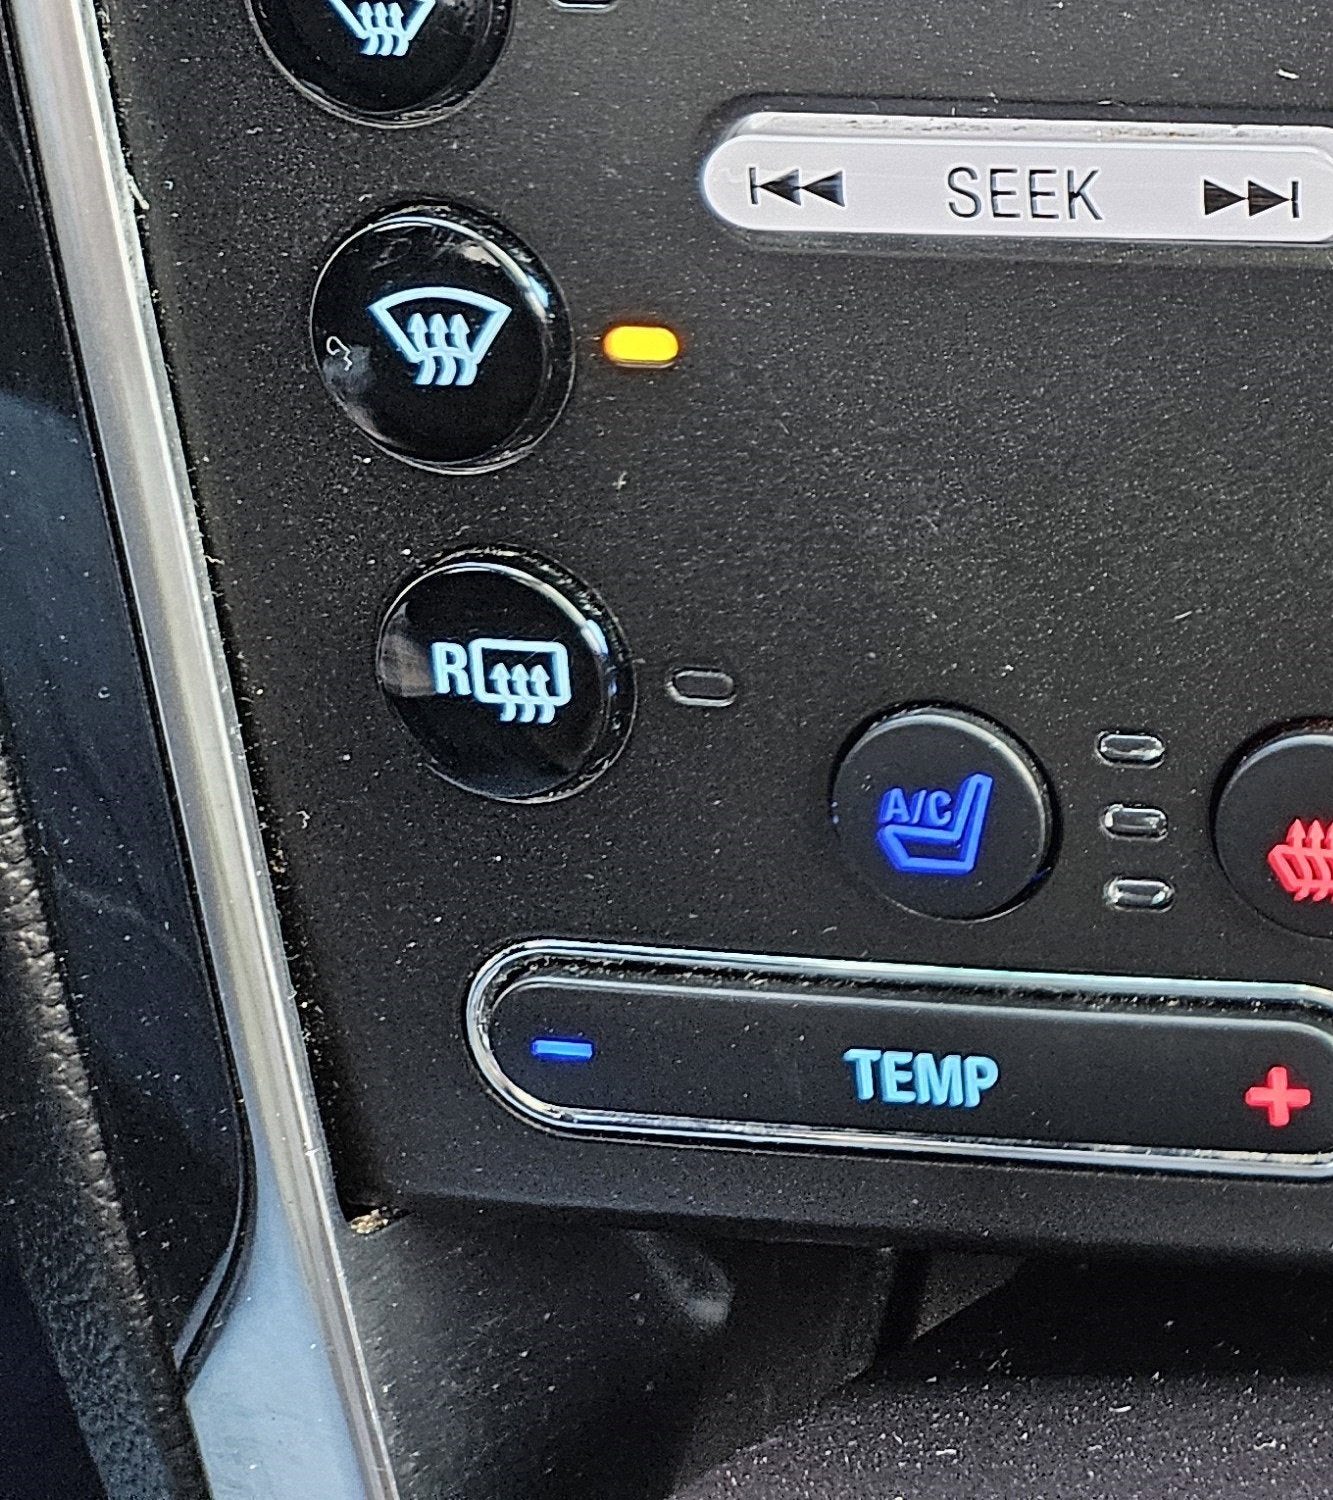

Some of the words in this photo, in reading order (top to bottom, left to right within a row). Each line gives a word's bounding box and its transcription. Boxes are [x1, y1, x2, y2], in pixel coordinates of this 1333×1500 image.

[946, 166, 1103, 221] SEEK
[880, 786, 953, 826] A/C
[843, 1049, 999, 1108] TEMP
